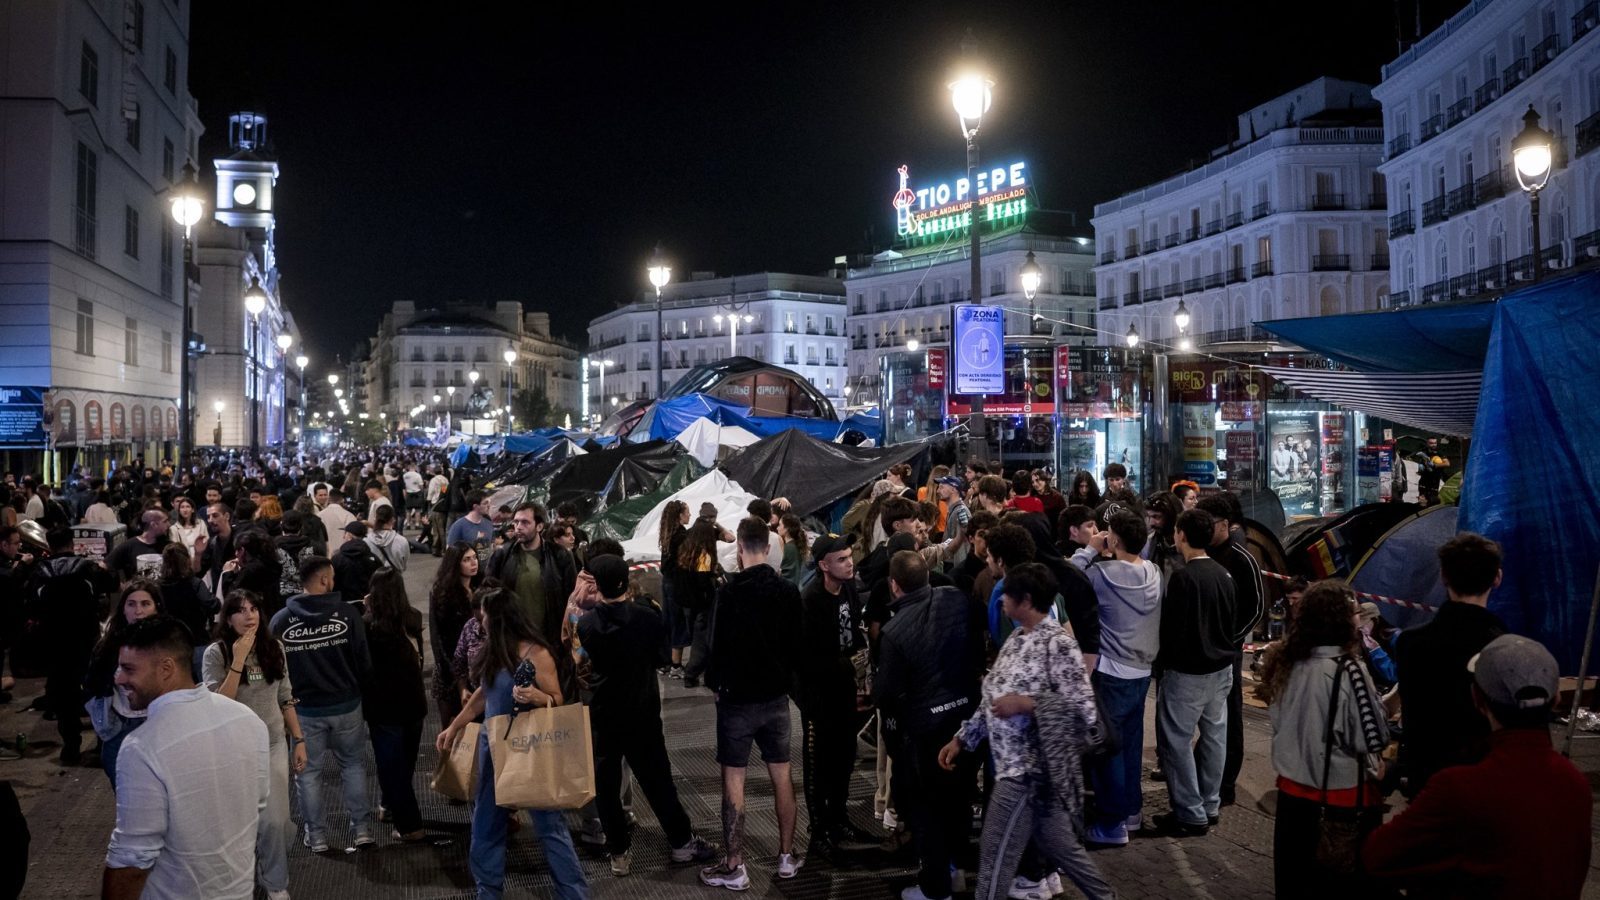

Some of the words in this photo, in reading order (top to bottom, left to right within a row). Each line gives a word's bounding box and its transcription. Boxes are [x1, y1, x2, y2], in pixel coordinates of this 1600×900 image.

[917, 183, 950, 210] TIO
[957, 161, 1025, 201] PEPE
[916, 213, 928, 221] SOL
[939, 201, 972, 215] ANDALUCI
[978, 188, 1025, 206] MBOTELLADO
[918, 212, 973, 237] GONZALE
[987, 198, 1027, 221] BYASS
[973, 310, 999, 318] ZONA
[1305, 359, 1340, 369] MADRD
[1173, 371, 1190, 381] BIG
[288, 623, 342, 639] SCALPERS
[285, 645, 304, 653] Street
[305, 641, 329, 651] Legend
[930, 704, 944, 714] we
[944, 700, 957, 711] are
[956, 696, 969, 706] one
[511, 730, 571, 748] PRIMARK
